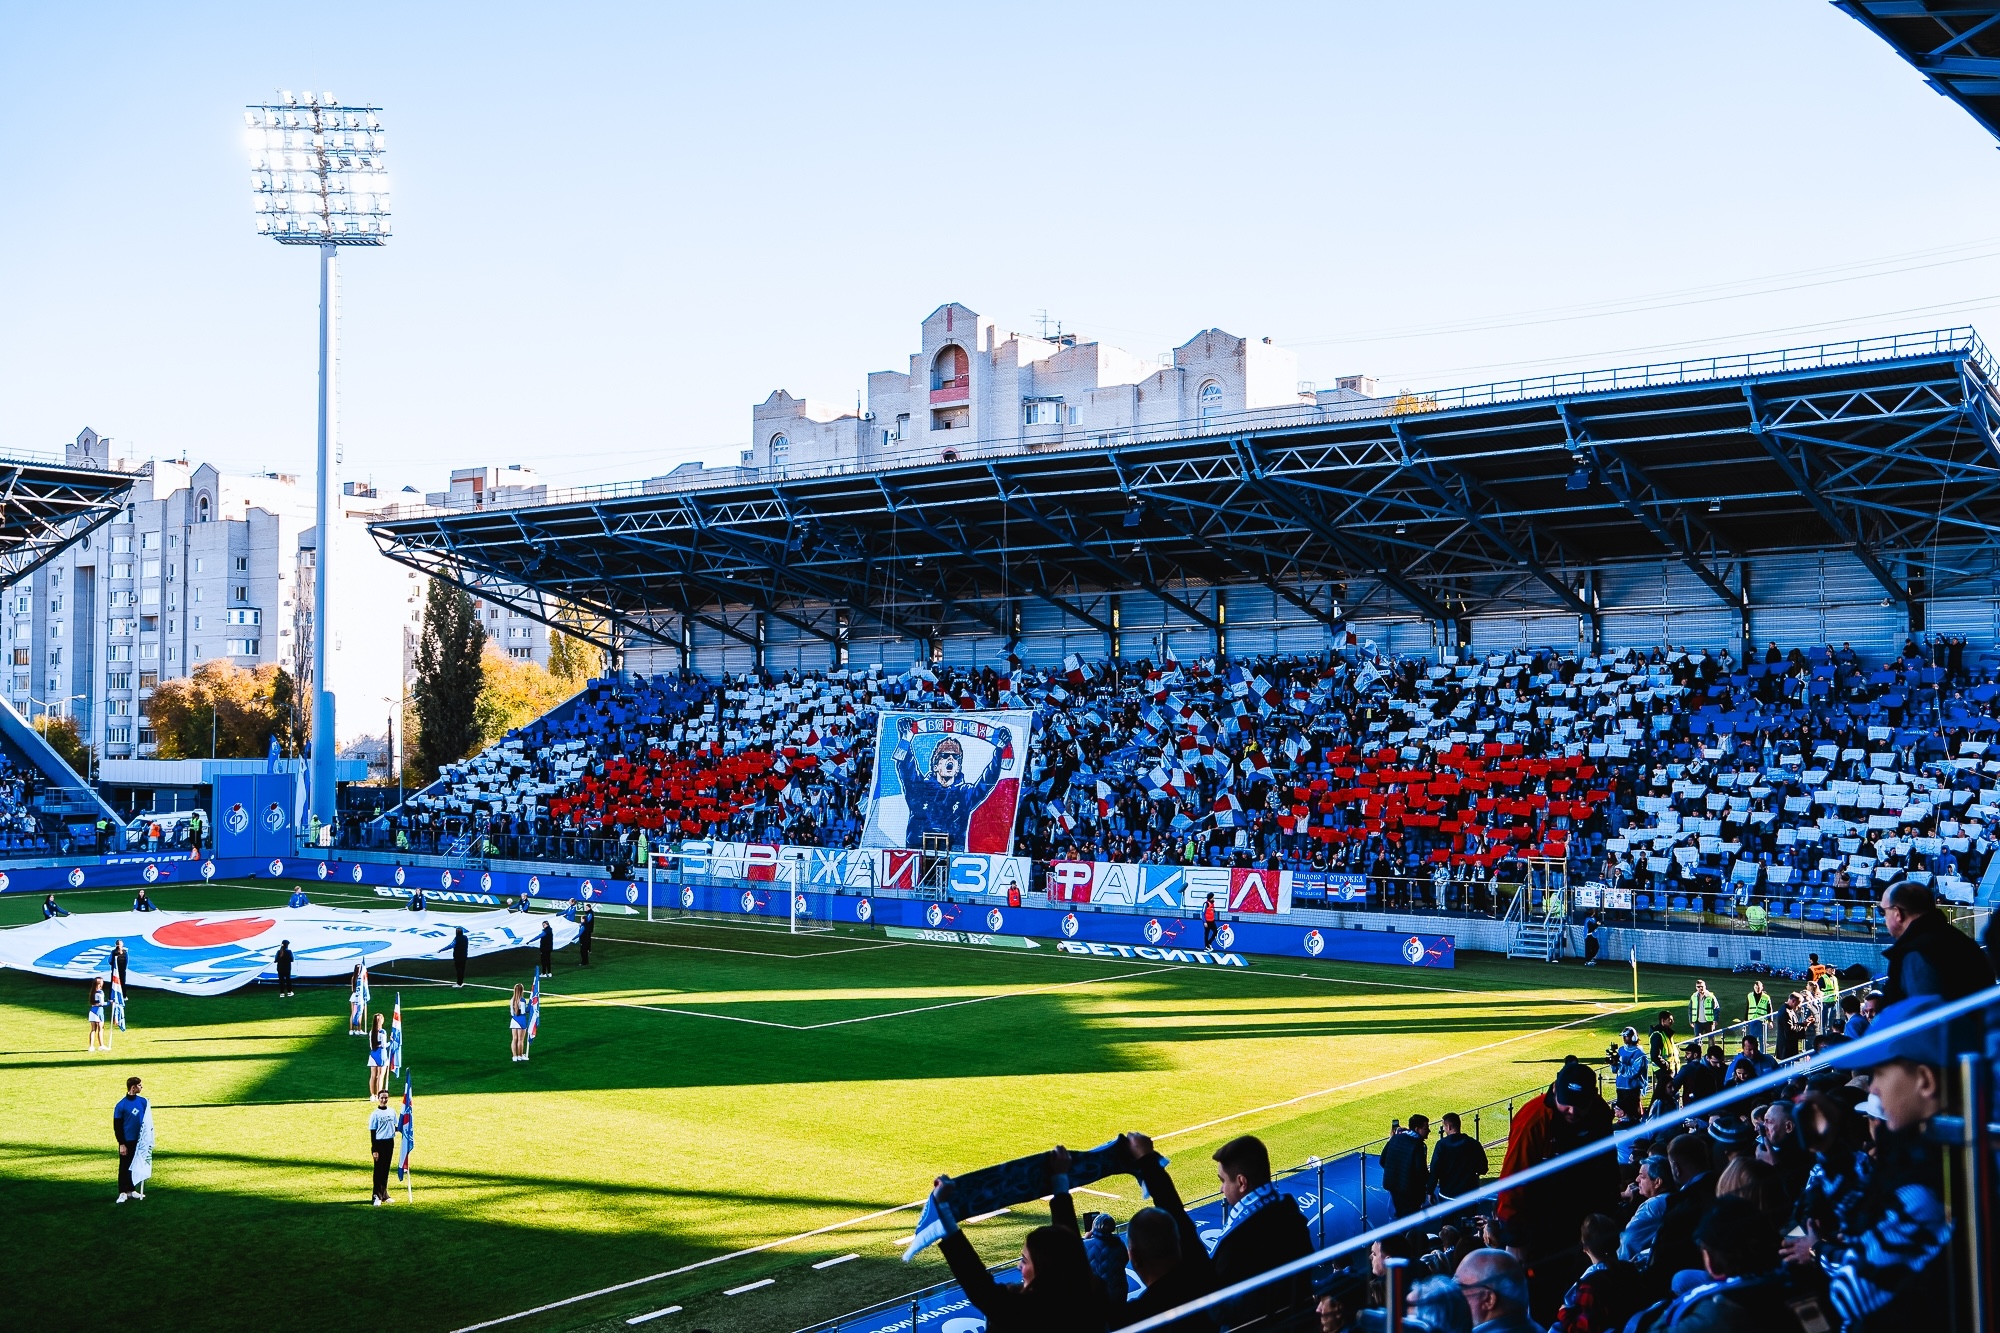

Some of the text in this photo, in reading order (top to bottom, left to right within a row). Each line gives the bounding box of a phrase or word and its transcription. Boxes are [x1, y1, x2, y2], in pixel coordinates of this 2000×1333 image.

[928, 720, 987, 738] ВОРОНЕЖ
[681, 840, 1275, 912] ЗАРЯЖАЙ ЗА ФАКЕЛ
[1329, 874, 1364, 883] ОТРОЖКА
[1061, 940, 1246, 966] БЕТСИТИ
[869, 1299, 972, 1333] ФИЦИАЛЬН
